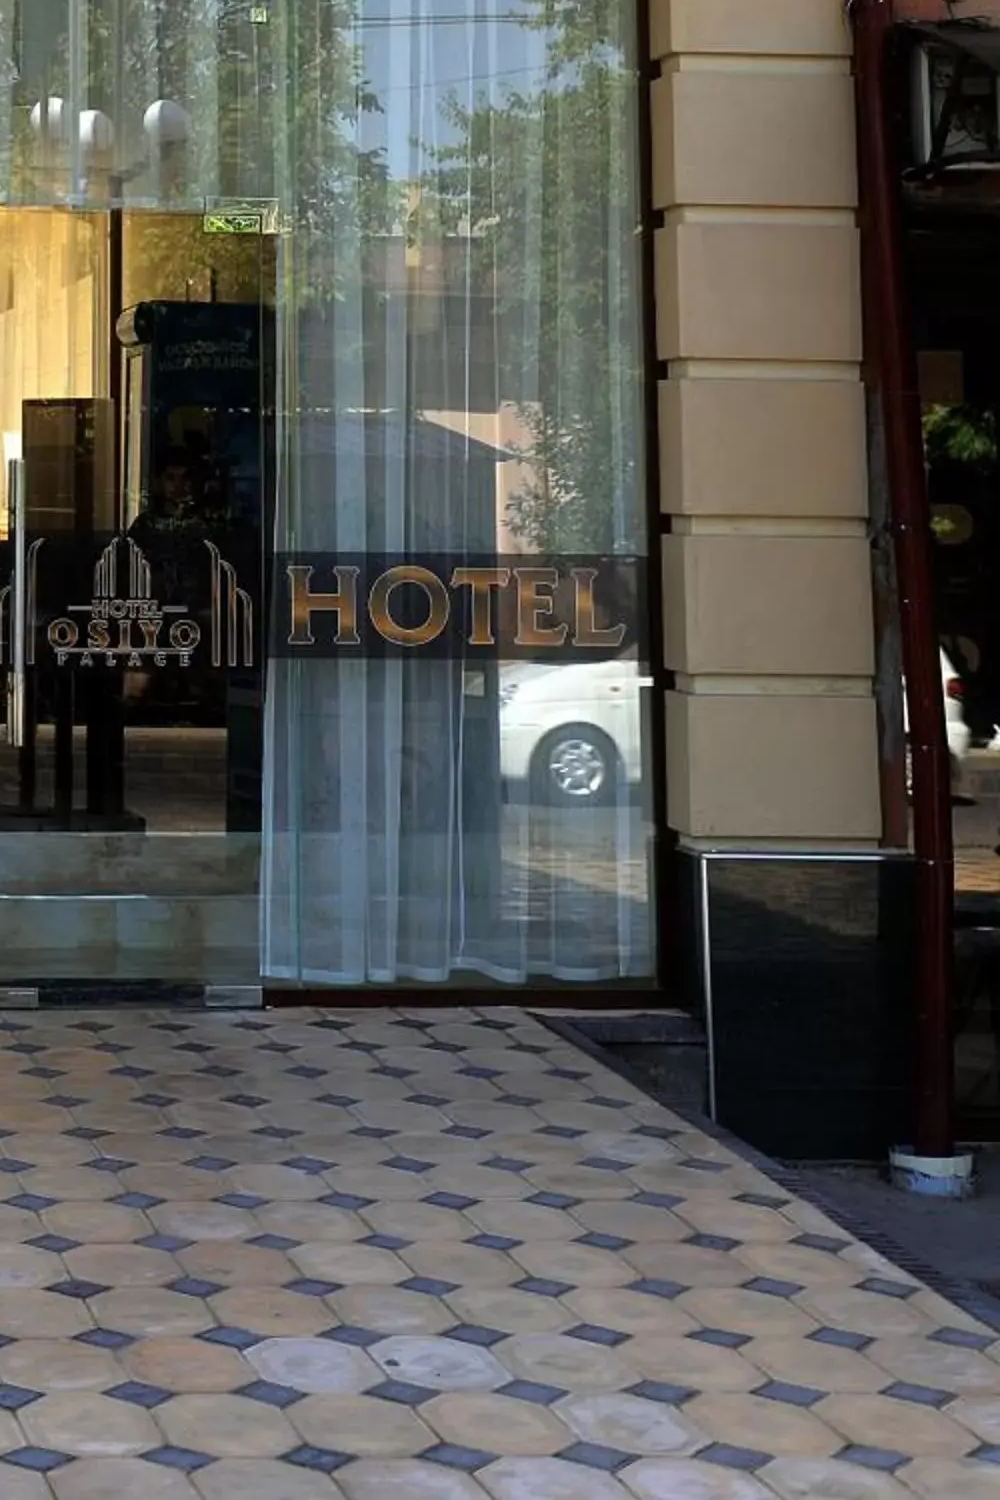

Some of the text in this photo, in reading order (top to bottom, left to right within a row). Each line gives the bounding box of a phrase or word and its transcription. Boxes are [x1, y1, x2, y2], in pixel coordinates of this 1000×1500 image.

[91, 600, 163, 619] HOTEL
[286, 565, 626, 647] HOTEL
[47, 618, 201, 649] OSIYO
[56, 651, 192, 667] PALACE
